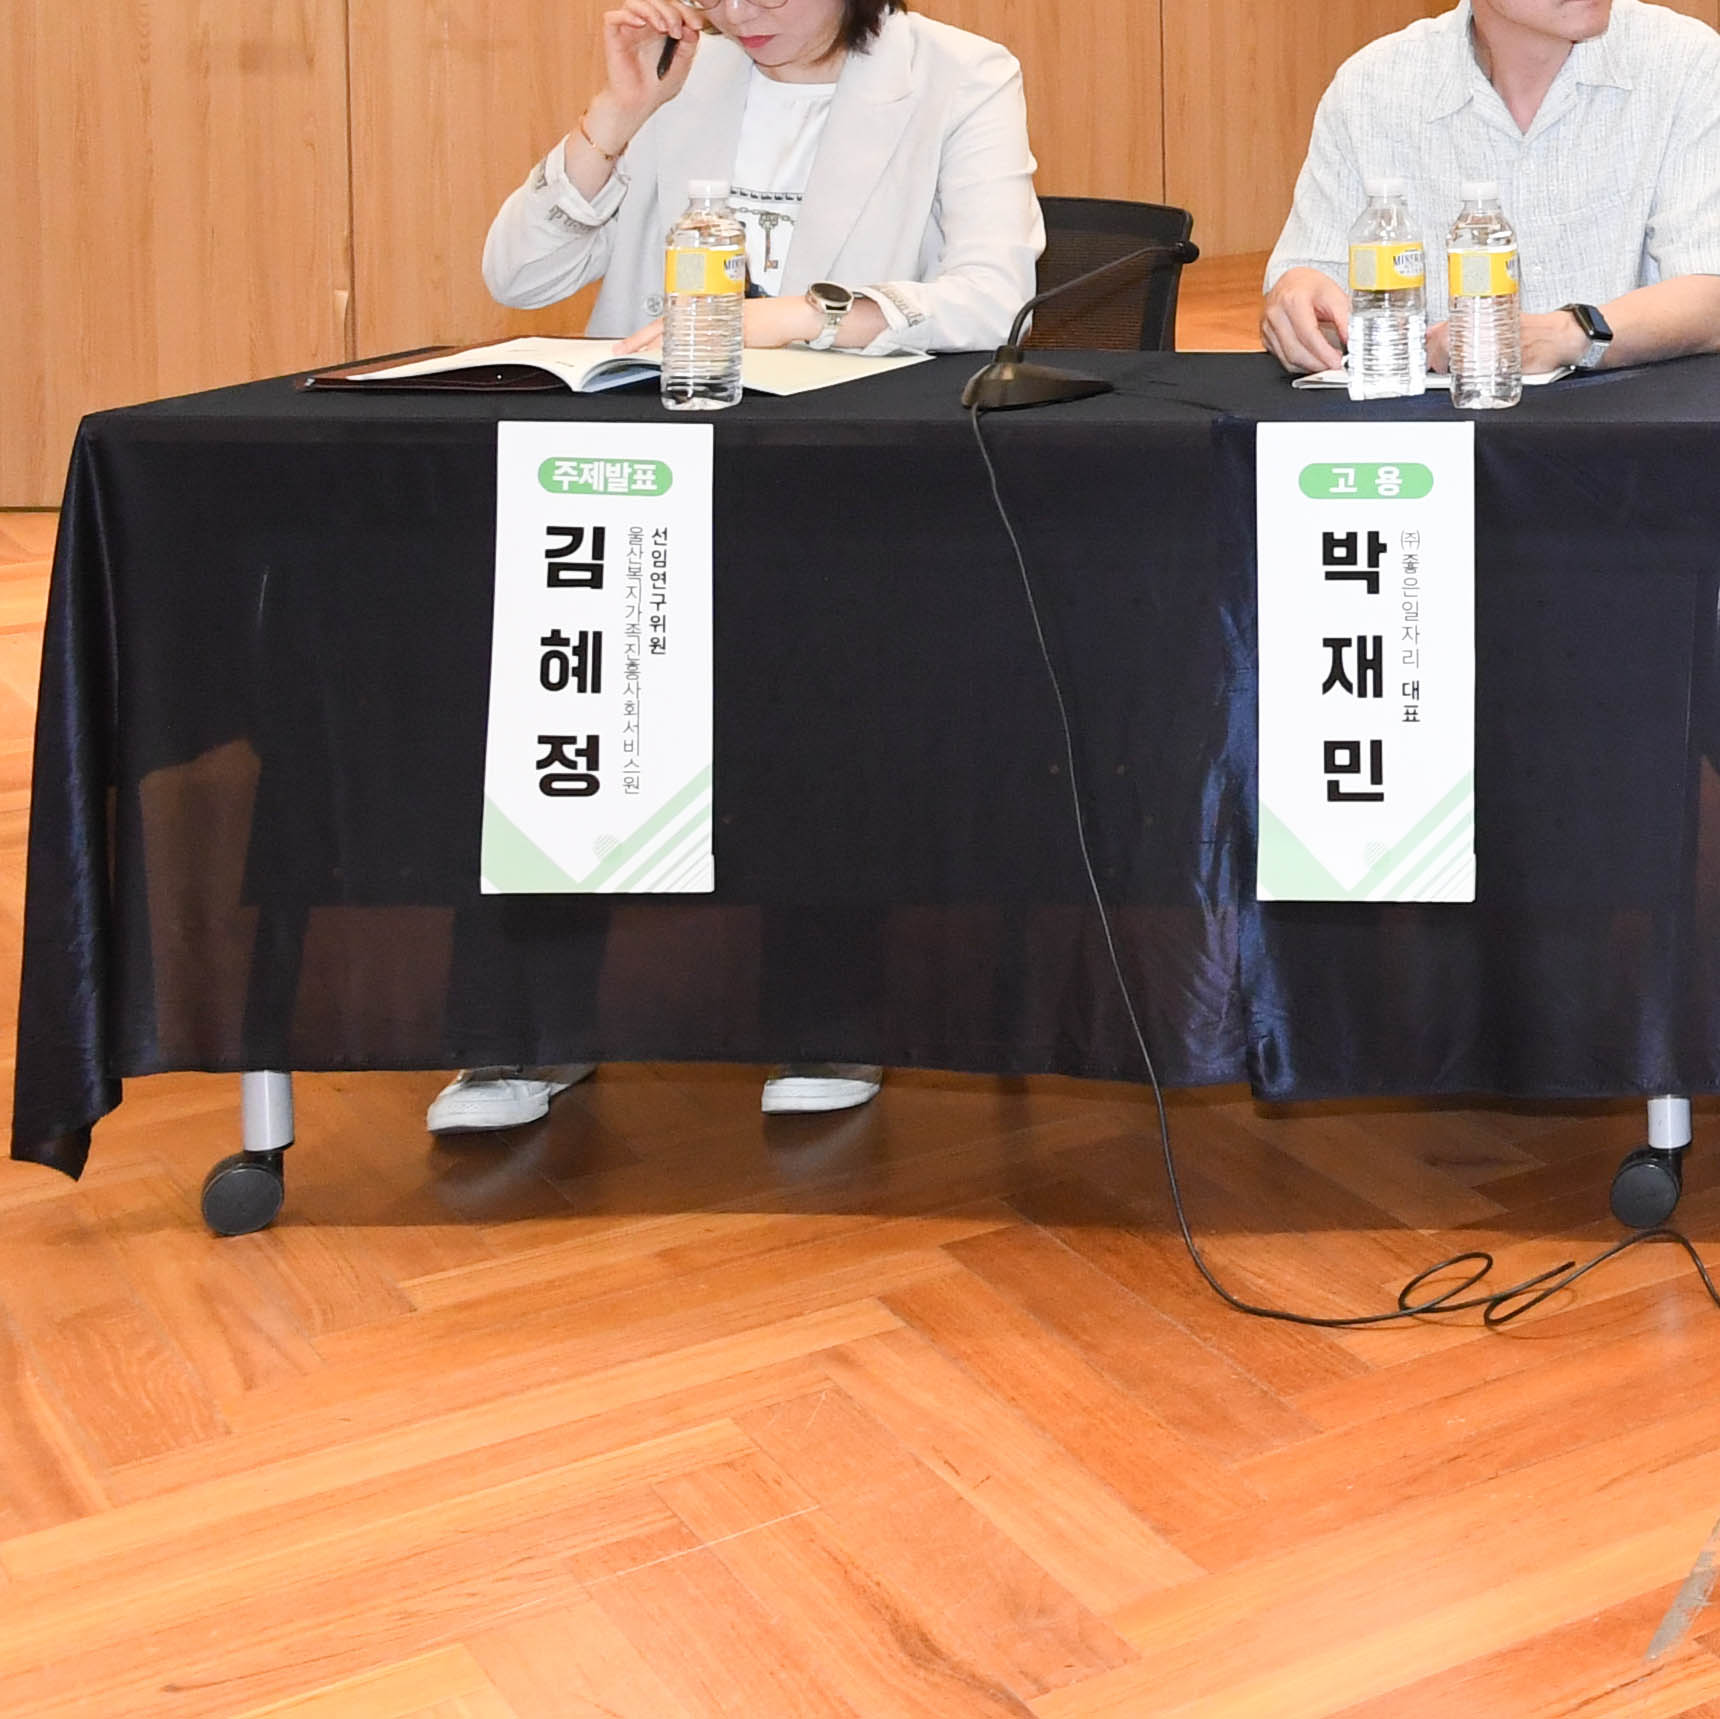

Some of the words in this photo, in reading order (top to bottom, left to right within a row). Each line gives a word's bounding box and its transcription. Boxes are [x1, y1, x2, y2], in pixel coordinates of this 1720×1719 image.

[551, 460, 658, 495] 주제발표
[534, 524, 607, 799] 김혜정
[622, 526, 645, 796] 울산복지가족진흥사회서비스원
[648, 526, 669, 656] 선임연구위원
[1320, 529, 1387, 803] 박재민
[1401, 679, 1421, 724] 대표
